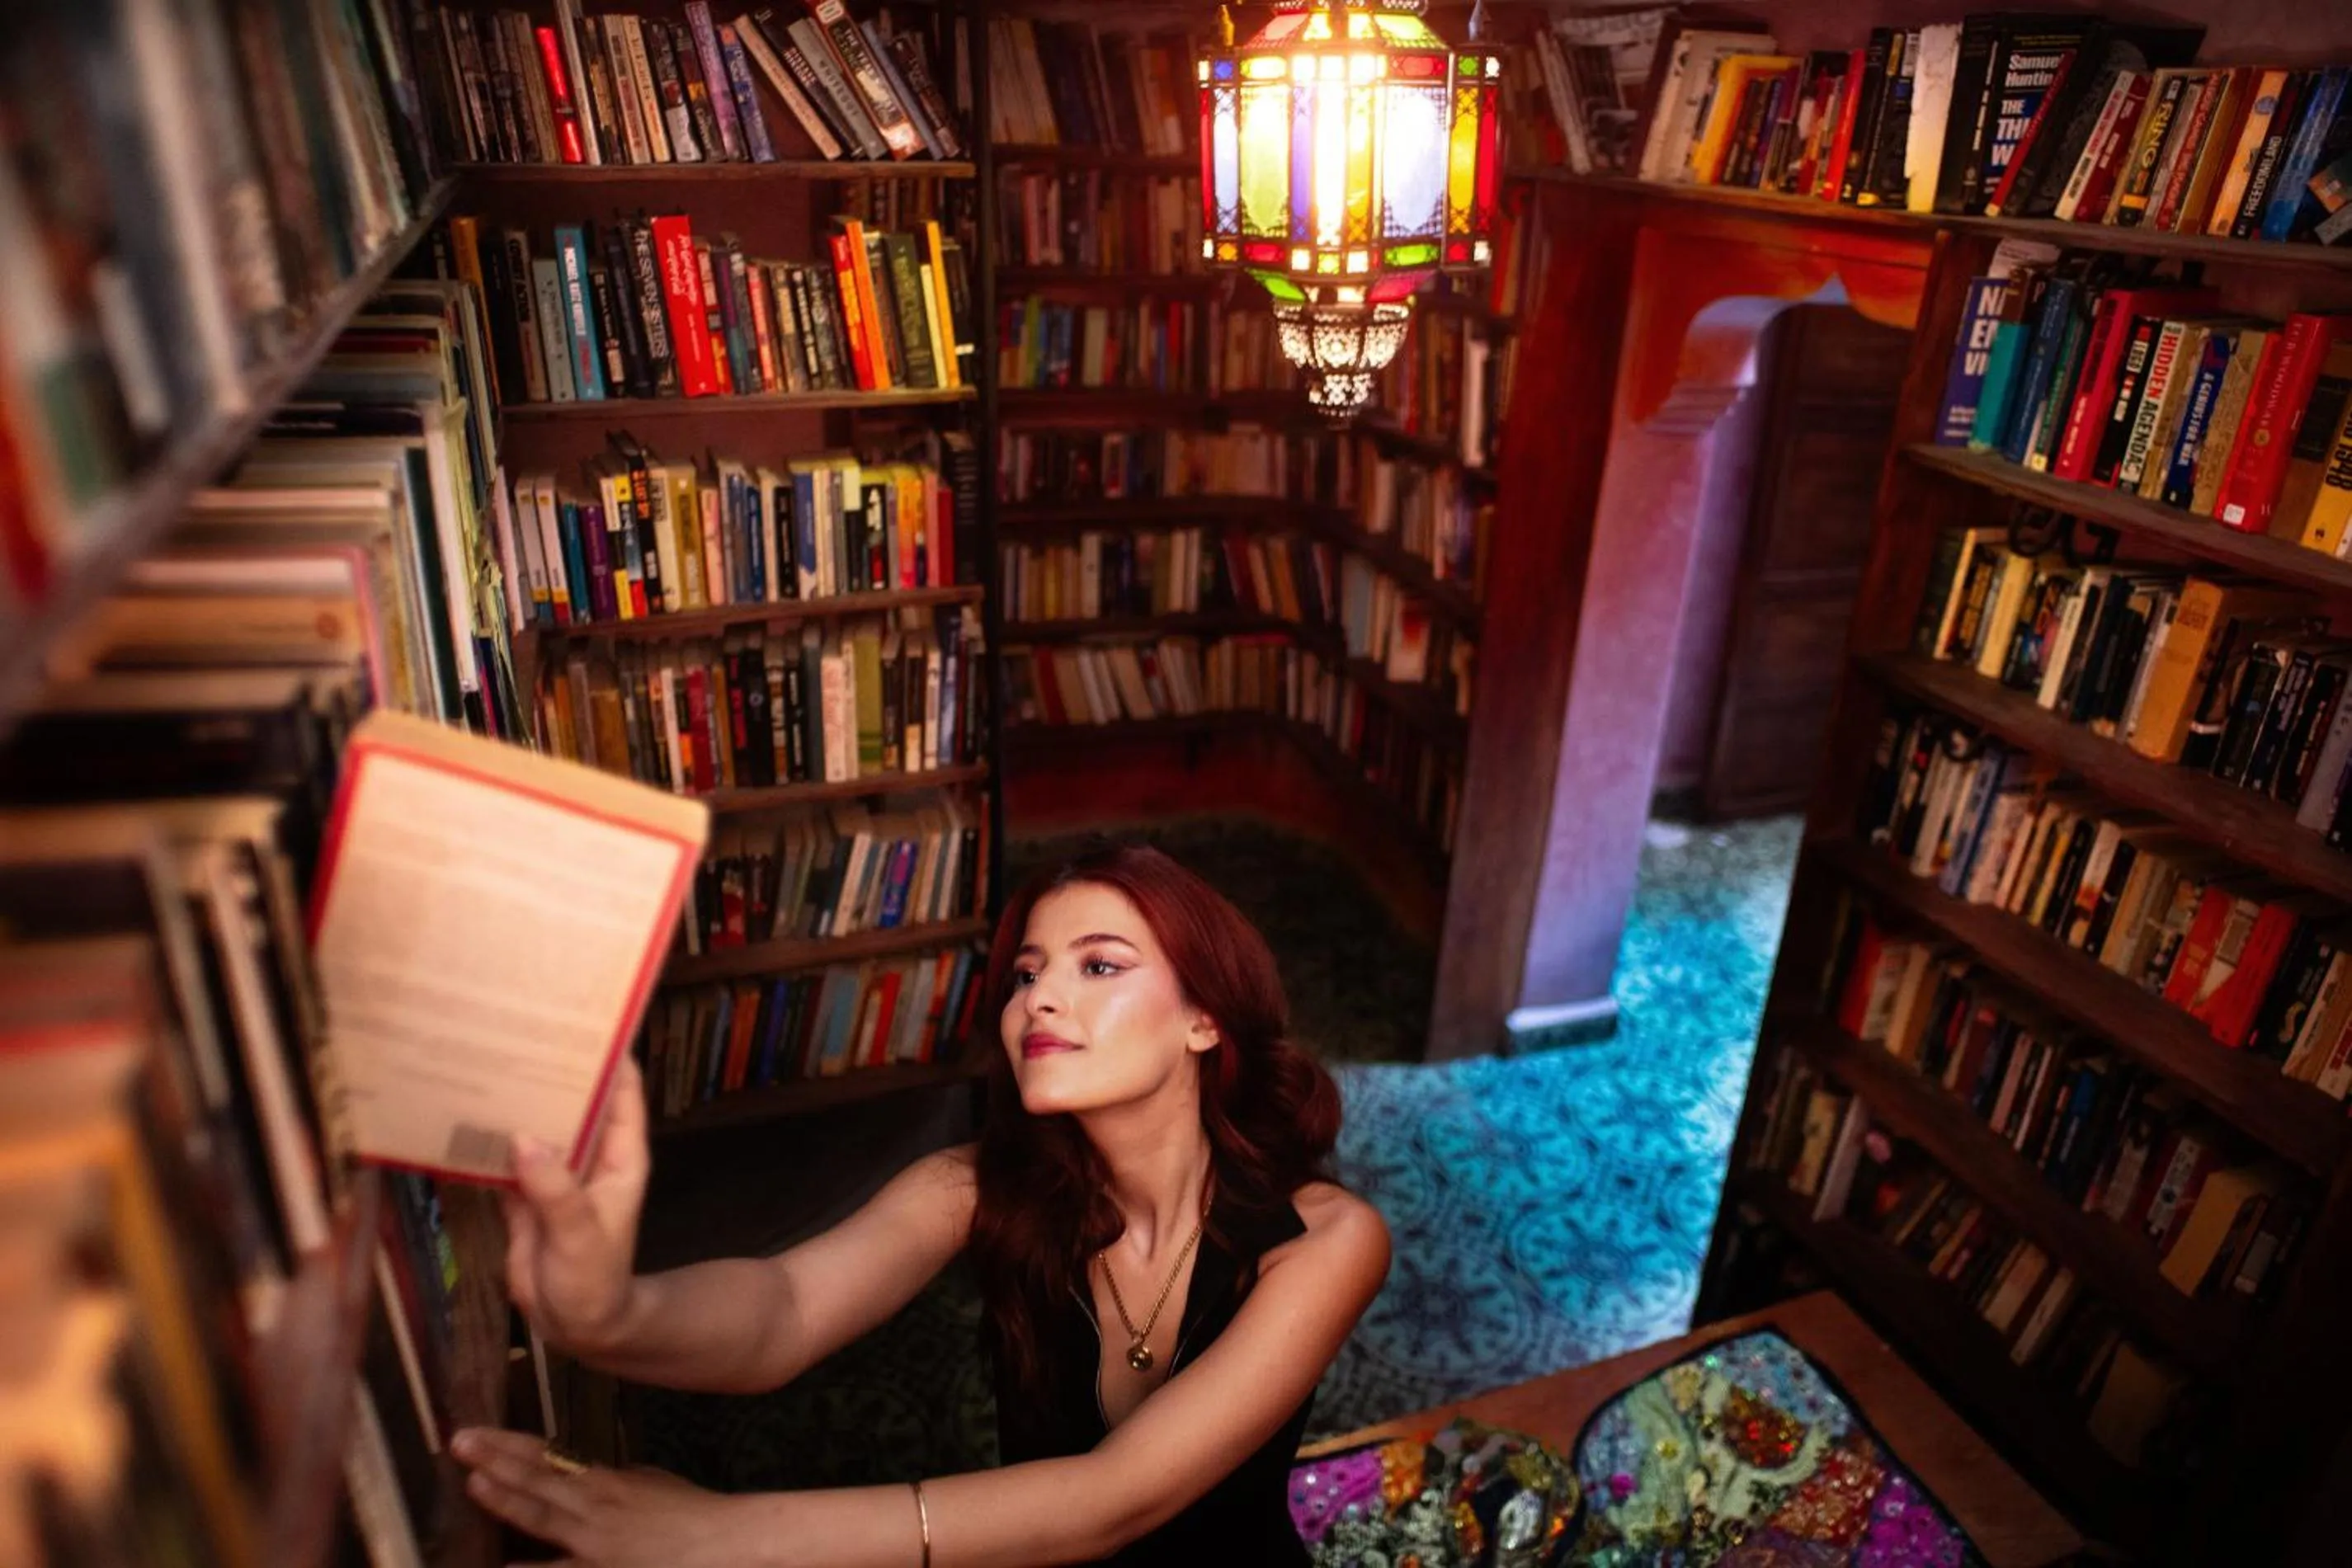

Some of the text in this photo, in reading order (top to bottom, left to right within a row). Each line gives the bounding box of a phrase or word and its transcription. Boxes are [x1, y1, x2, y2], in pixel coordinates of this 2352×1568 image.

[2001, 99, 2026, 115] THE
[2005, 71, 2054, 87] Huntin
[2142, 101, 2173, 168] RING
[2244, 135, 2283, 218] FREEDOMLAND
[2146, 333, 2178, 400] HIDDEN
